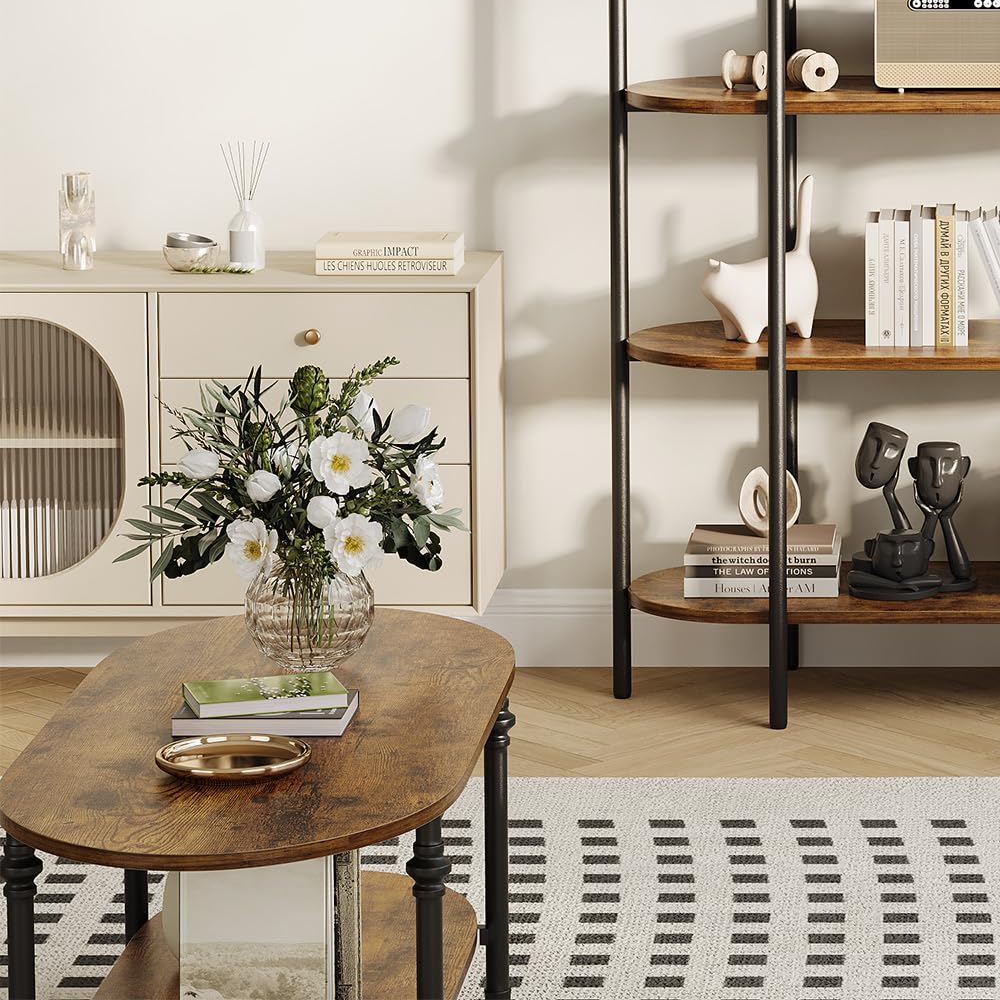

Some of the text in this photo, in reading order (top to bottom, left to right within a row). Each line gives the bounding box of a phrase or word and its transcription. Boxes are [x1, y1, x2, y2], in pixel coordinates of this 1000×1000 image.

[939, 220, 952, 249] ДУМАЙ
[353, 246, 419, 257] GRAPHIC IMPACT
[323, 261, 447, 271] LES CHIENS HUOLES RETROVISEUR
[939, 259, 949, 290] ДРУГИХ
[957, 269, 965, 300] РАССКАЖИ
[940, 292, 949, 335] ФОРМАТАХ
[957, 301, 965, 314] МНЕ
[957, 320, 965, 336] МОРЕ
[715, 583, 751, 593] Houses
